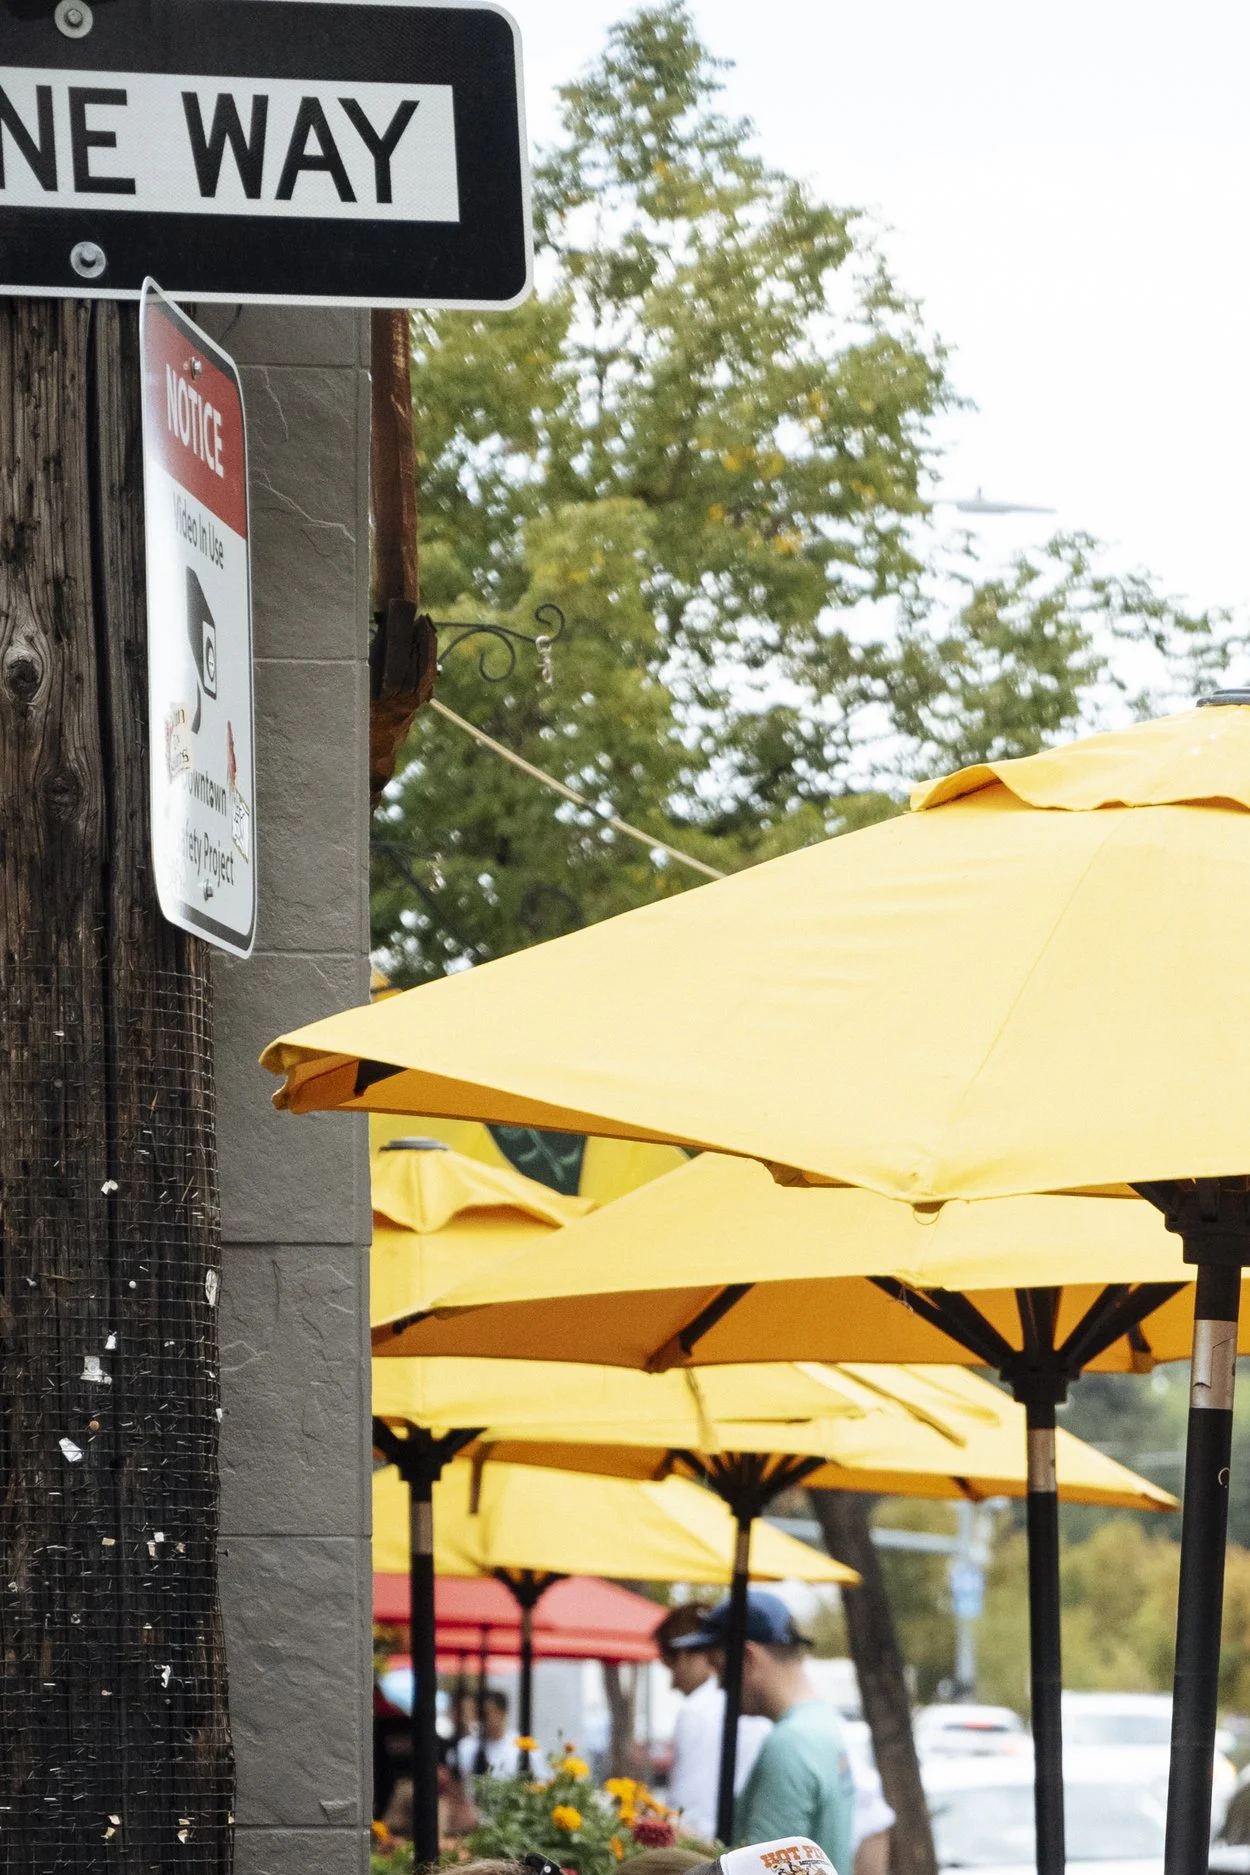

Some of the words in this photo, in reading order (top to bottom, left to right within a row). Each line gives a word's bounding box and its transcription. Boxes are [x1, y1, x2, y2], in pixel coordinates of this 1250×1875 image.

[0, 85, 136, 194] NE
[181, 91, 420, 204] WAY
[165, 363, 225, 478] NOTICE
[173, 492, 197, 547] Video
[199, 513, 208, 557] In
[208, 521, 224, 570] Use
[203, 831, 234, 888] Project
[760, 1846, 801, 1869] HOT
